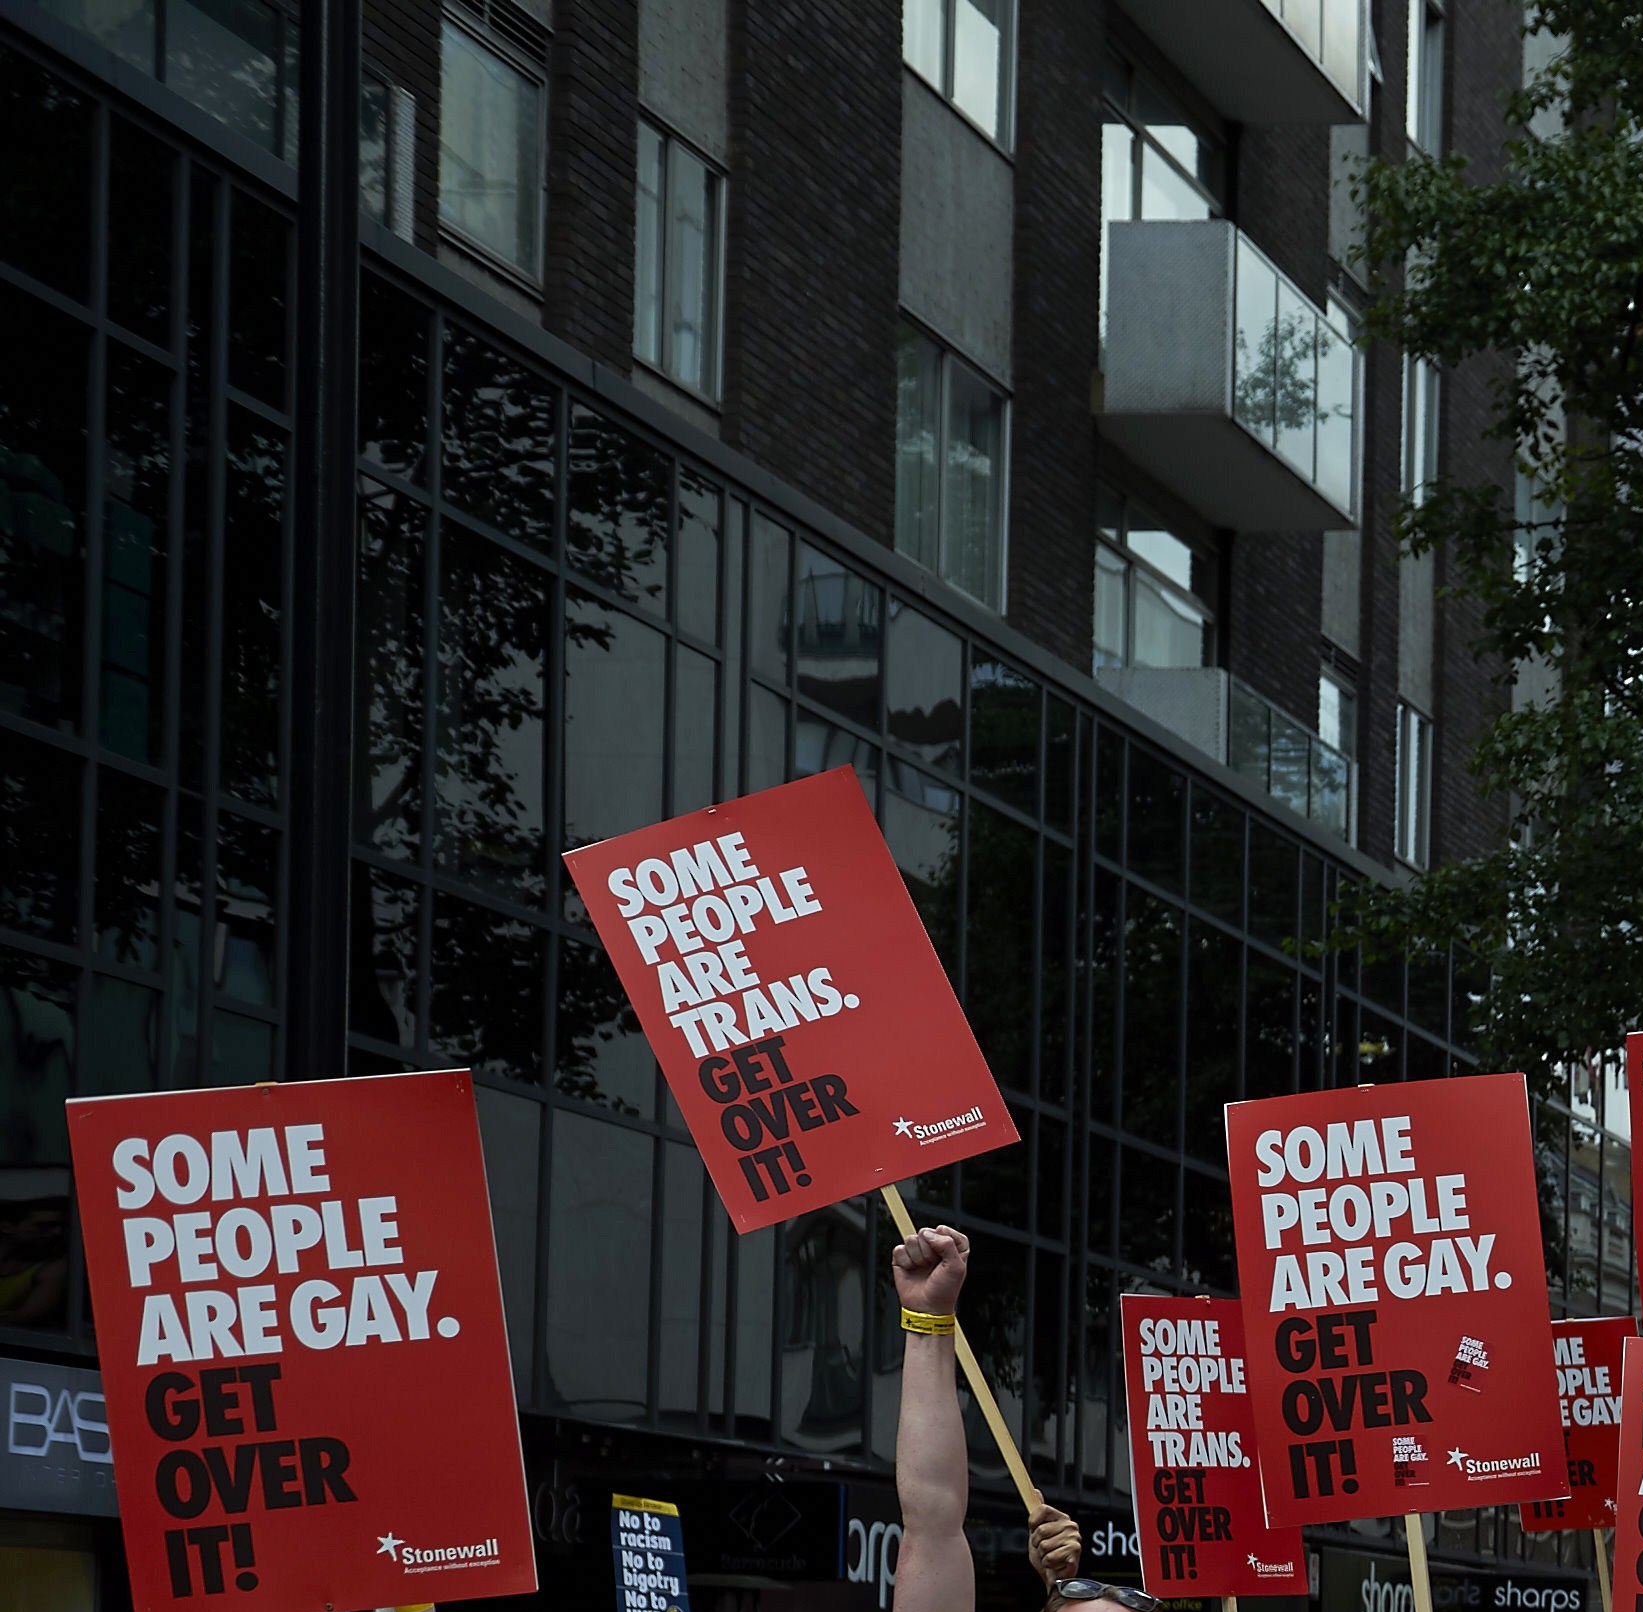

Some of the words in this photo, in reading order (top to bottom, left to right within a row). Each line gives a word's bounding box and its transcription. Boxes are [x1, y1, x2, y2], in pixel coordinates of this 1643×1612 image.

[607, 831, 760, 917] SOME
[627, 866, 823, 965] PEOPLE
[657, 939, 759, 1014] ARE
[669, 967, 860, 1058] TRANS.
[698, 1035, 794, 1103] GET
[720, 1073, 860, 1151] OVER
[914, 1106, 984, 1141] Stonewall
[112, 1124, 330, 1209] SOME
[738, 1149, 812, 1201] IT!
[1255, 1116, 1414, 1188] SOME
[122, 1196, 403, 1288] PEOPLE
[1262, 1174, 1469, 1250] PEOPLE
[1269, 1246, 1383, 1313] ARE
[1383, 1234, 1512, 1297] GAY.
[137, 1285, 283, 1366] ARE
[290, 1270, 461, 1350] GAY.
[1140, 1318, 1221, 1358] SOME
[1275, 1311, 1377, 1374] GET
[145, 1363, 281, 1442] GET
[1143, 1356, 1246, 1394] PEOPLE
[1281, 1369, 1434, 1437] OVER
[1147, 1393, 1202, 1431] ARE
[156, 1437, 357, 1519] OVER
[1148, 1431, 1251, 1468] TRANS.
[1289, 1439, 1357, 1499] IT!
[1466, 1453, 1540, 1474] Stonewall
[1153, 1469, 1206, 1504] GET
[402, 1538, 499, 1564] Stonewall
[619, 1511, 640, 1530] No
[643, 1512, 661, 1531] to
[620, 1532, 672, 1551] racism
[1156, 1505, 1233, 1542] OVER
[164, 1524, 258, 1598] IT!
[622, 1551, 643, 1570] No
[647, 1553, 664, 1571] to
[623, 1569, 680, 1597] bigotry
[1160, 1543, 1198, 1581] IT!
[1256, 1561, 1294, 1574] Stonewall
[625, 1591, 647, 1609] No
[649, 1592, 667, 1610] to
